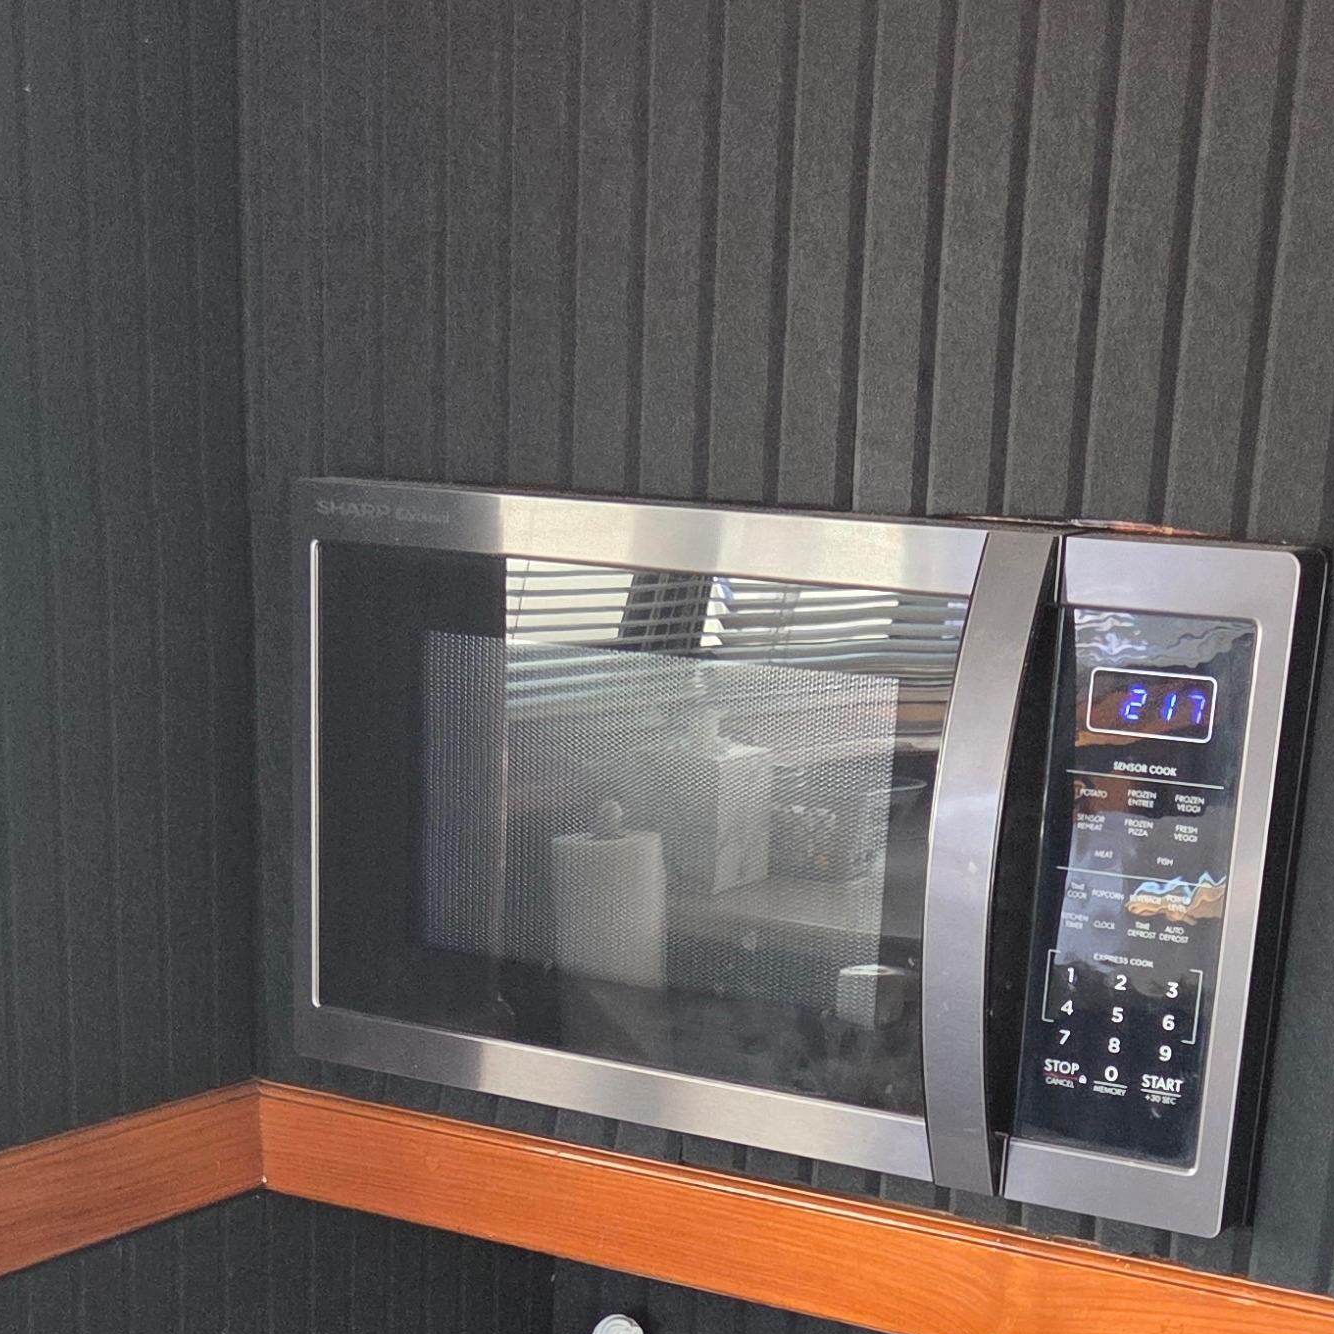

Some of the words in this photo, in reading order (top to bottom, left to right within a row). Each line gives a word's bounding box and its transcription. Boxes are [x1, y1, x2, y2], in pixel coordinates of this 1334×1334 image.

[315, 499, 391, 518] SHARP
[1113, 761, 1147, 773] SENSOR
[1149, 764, 1177, 777] COOK
[1080, 788, 1107, 799] POTATO
[1127, 789, 1157, 800] FROZEN
[1175, 794, 1205, 805] FROZEN
[1128, 799, 1155, 809] ENTREE
[1077, 813, 1106, 823] SENSOR
[1124, 818, 1154, 829] FROZEN
[1128, 827, 1149, 837] PIZZA
[1094, 850, 1114, 859] MEAT
[1156, 856, 1174, 866] FISH
[1067, 889, 1088, 899] COOK
[1091, 888, 1125, 901] POPCORN
[1093, 920, 1115, 930] CLOCK
[1164, 925, 1185, 935] AUTO
[1127, 929, 1156, 940] DEFROST
[1158, 932, 1190, 944] DEFROST
[1093, 953, 1128, 965] EXPRESS
[1129, 957, 1154, 969] COOK
[1067, 967, 1075, 983] 1
[1114, 974, 1127, 991] 2
[1165, 981, 1179, 999] 3
[1060, 999, 1074, 1016] 4
[1111, 1007, 1124, 1023] 5
[1162, 1014, 1175, 1031] 6
[1058, 1029, 1071, 1045] 7
[1108, 1037, 1121, 1054] 8
[1158, 1045, 1172, 1062] 9
[1043, 1058, 1080, 1075] STOP
[1104, 1065, 1119, 1082] 0
[1045, 1076, 1075, 1089] CANCEL
[1141, 1074, 1184, 1093] START
[1093, 1085, 1127, 1097] MEMORY
[1162, 1096, 1177, 1105] SEC
